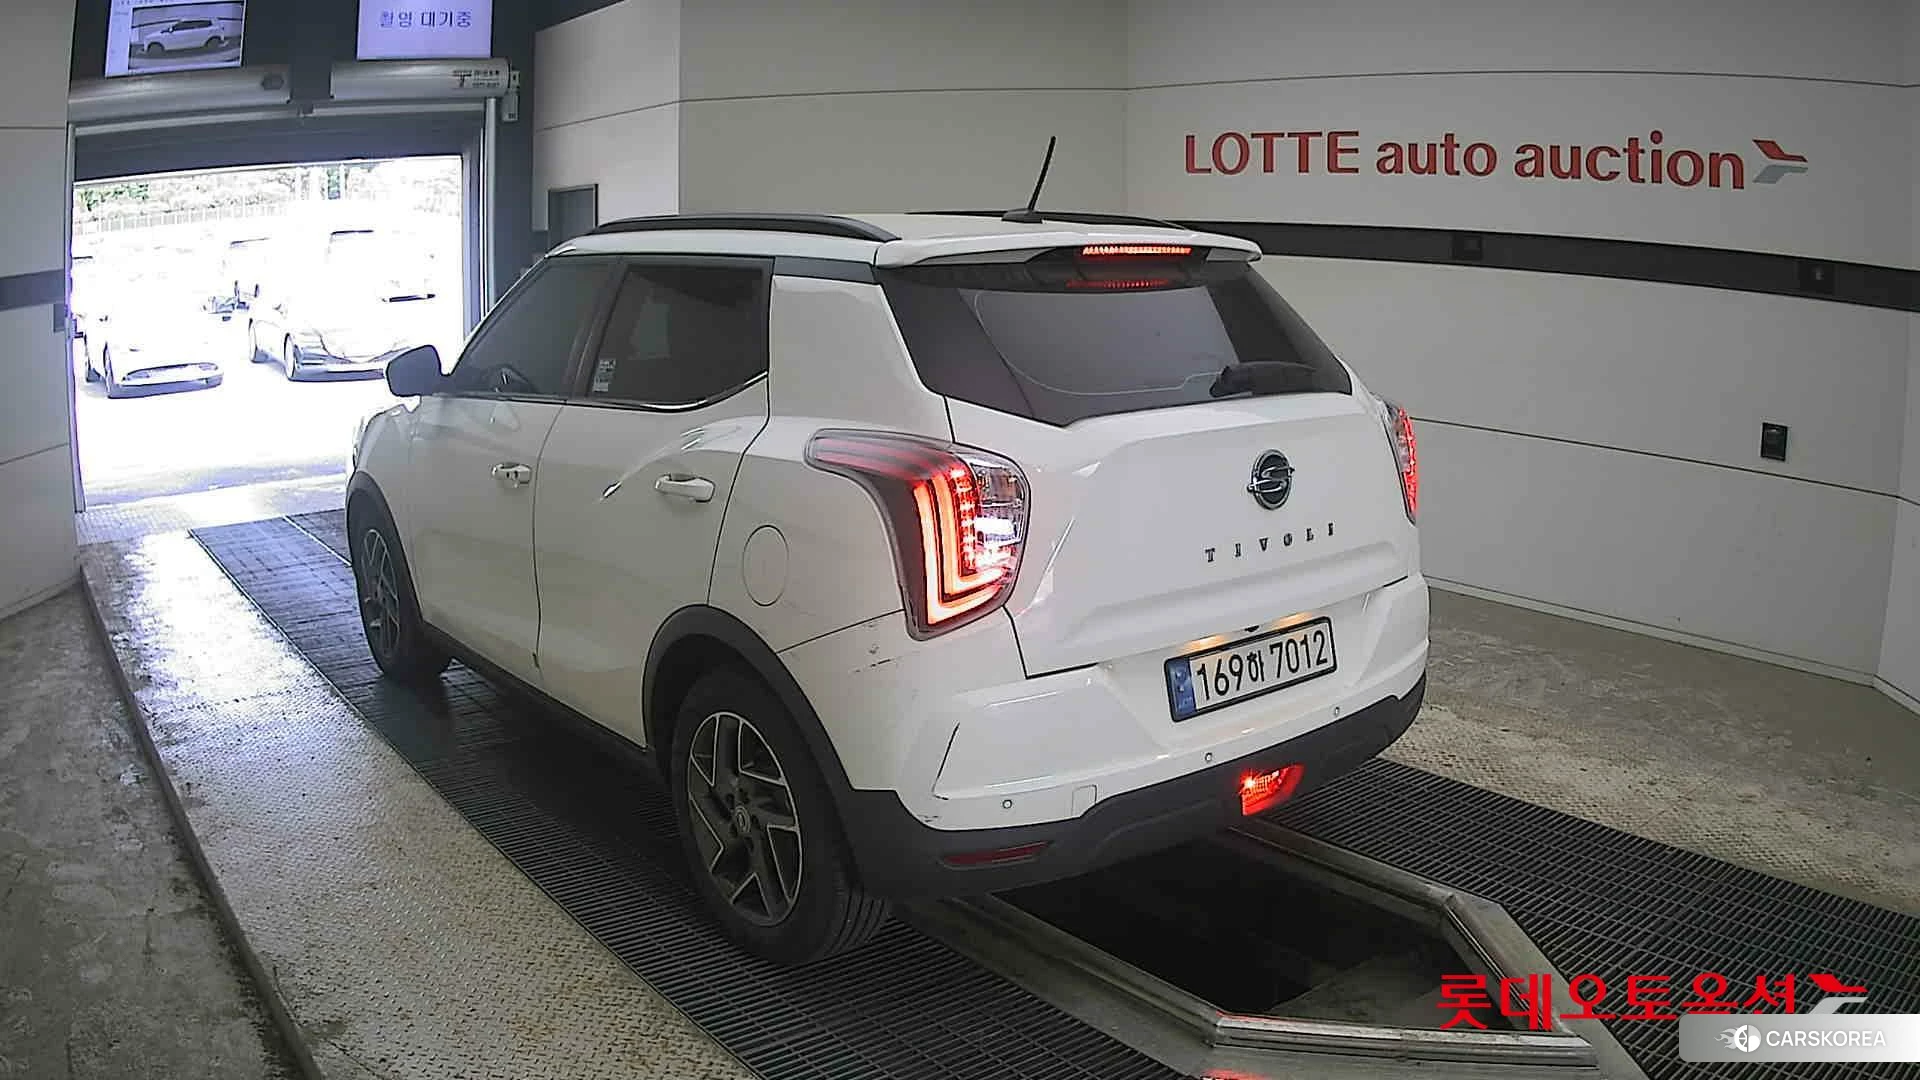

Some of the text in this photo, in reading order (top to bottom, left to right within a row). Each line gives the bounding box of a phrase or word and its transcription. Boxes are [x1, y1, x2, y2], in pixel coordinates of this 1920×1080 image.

[421, 11, 471, 28] 대기중
[1185, 130, 1745, 189] LOTTE auto auction
[1205, 522, 1334, 562] TIVOLI
[1197, 630, 1328, 700] 169하 7012
